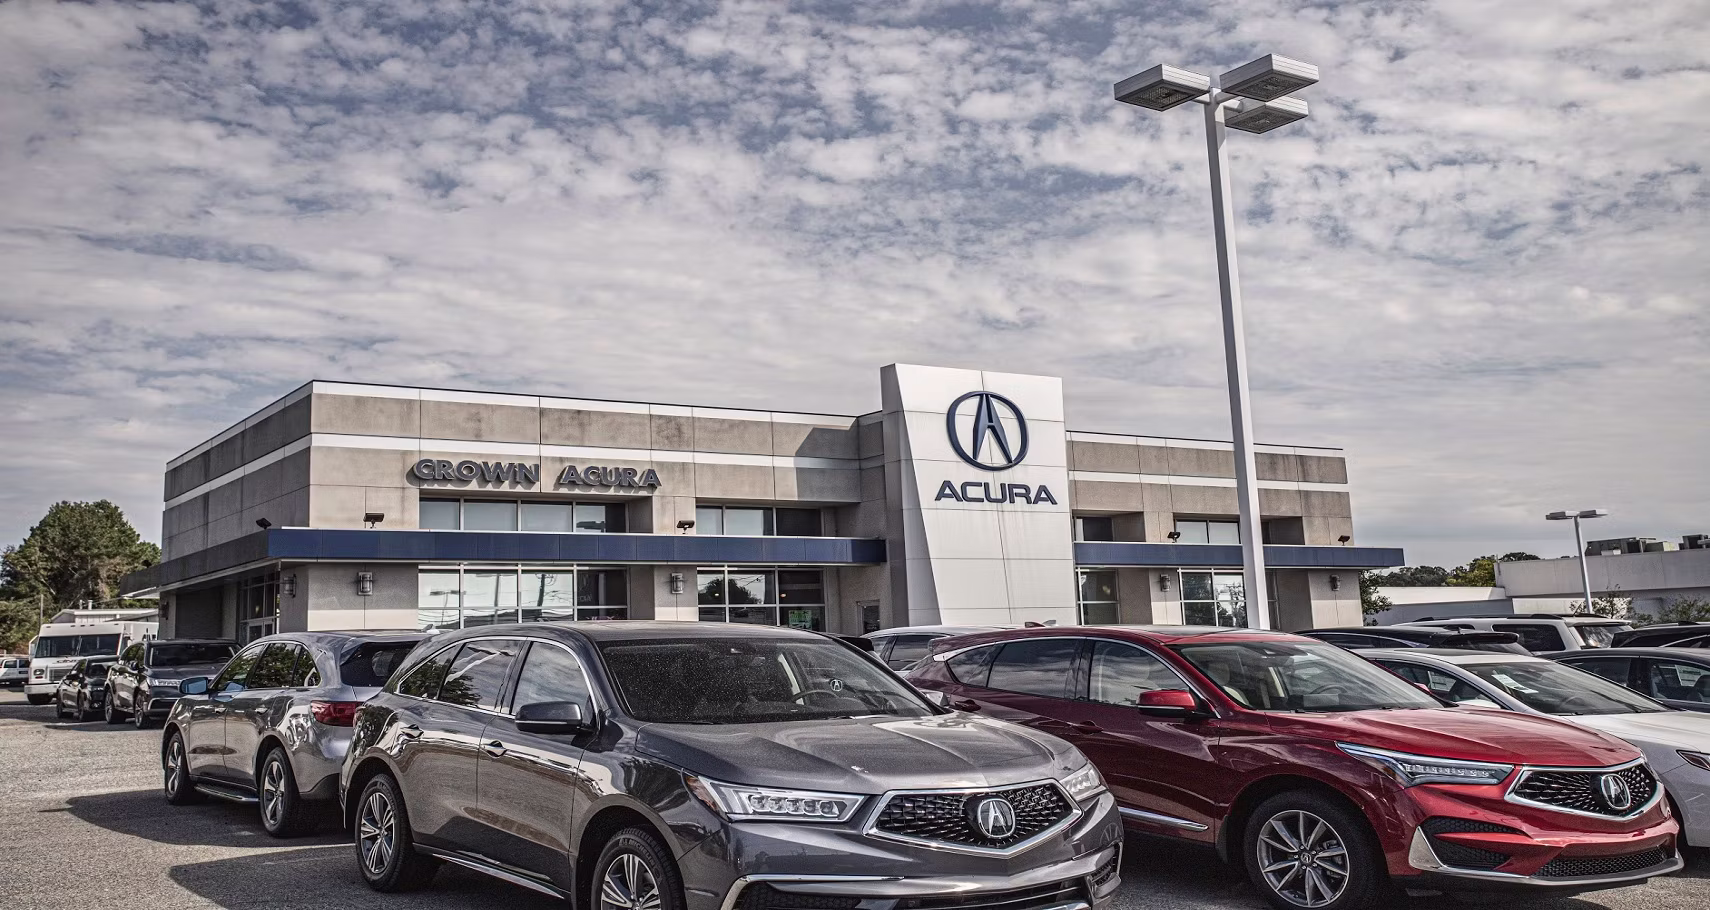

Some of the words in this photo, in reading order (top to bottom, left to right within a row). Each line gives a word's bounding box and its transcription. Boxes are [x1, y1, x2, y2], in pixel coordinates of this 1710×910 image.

[414, 458, 540, 483] CROWN
[558, 465, 663, 488] ACURA
[934, 480, 1058, 505] ACURA
[628, 839, 656, 867] MICHELIN
